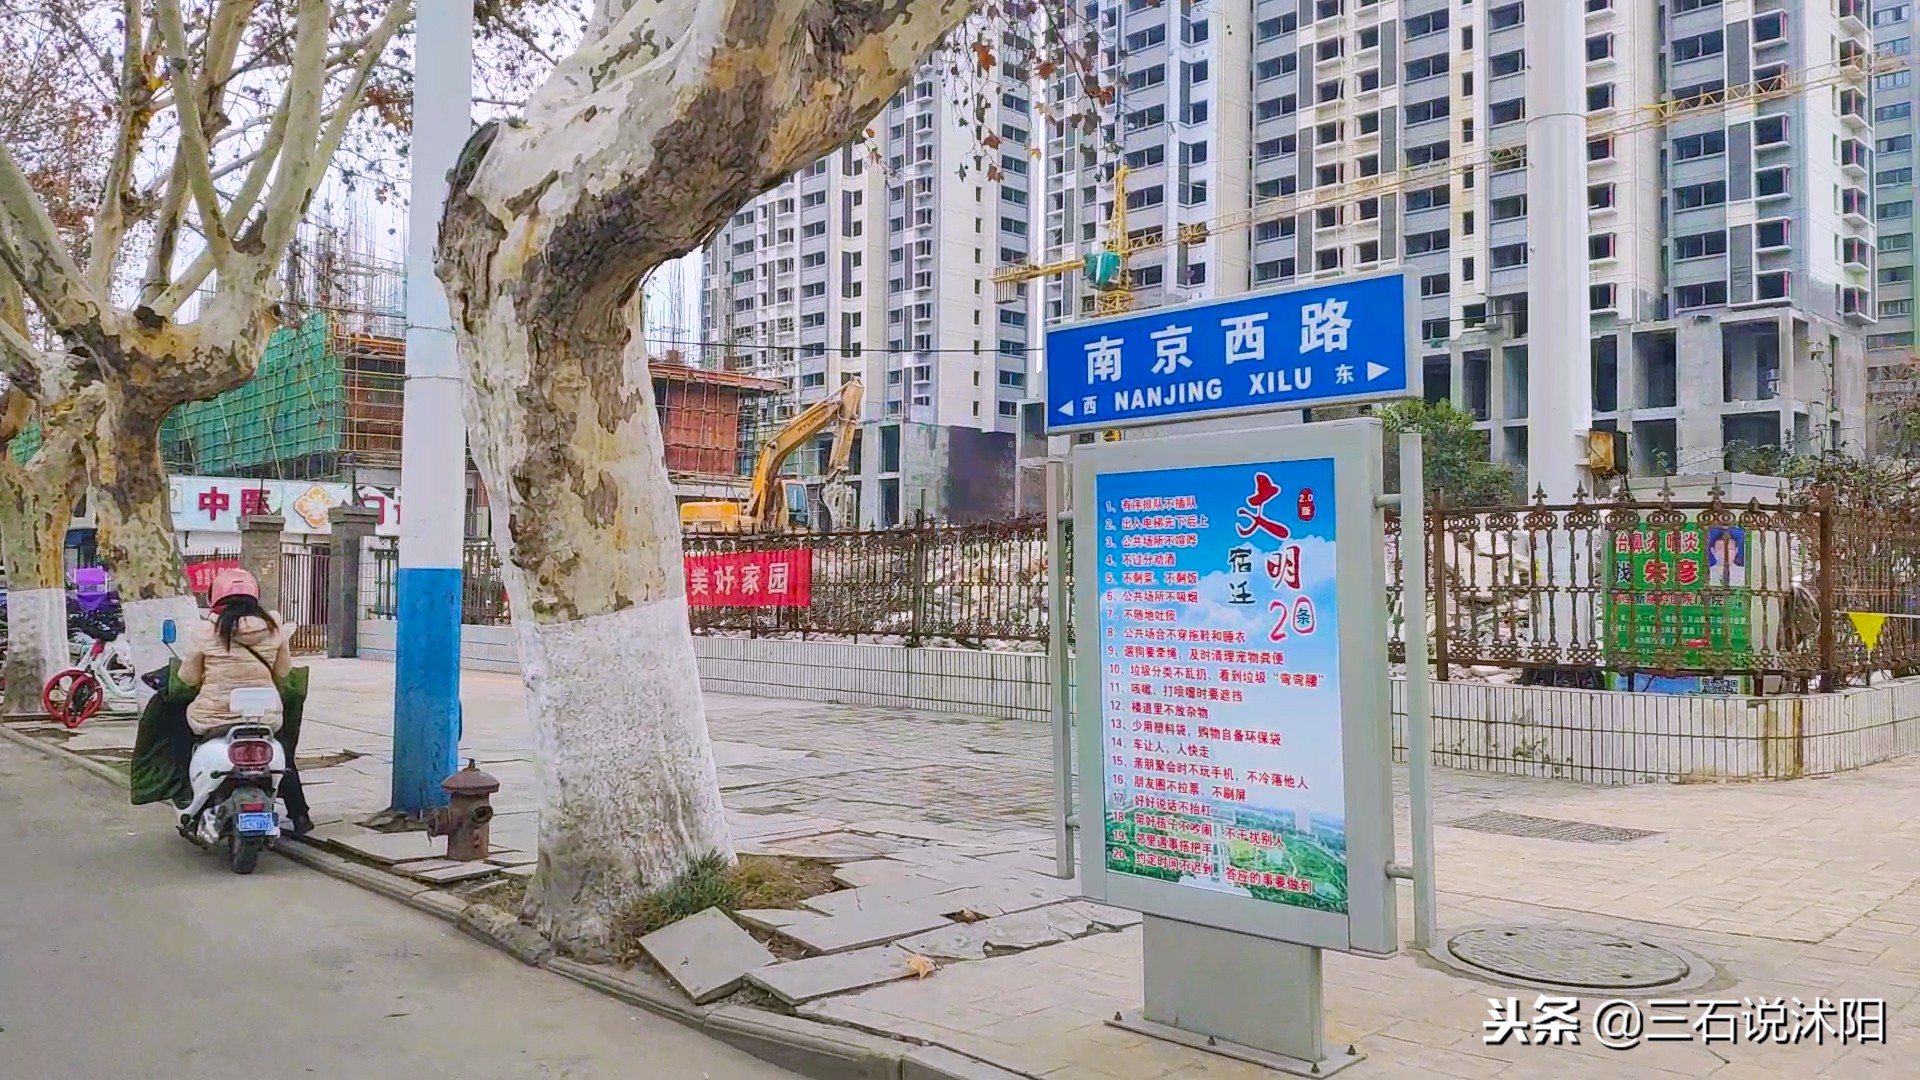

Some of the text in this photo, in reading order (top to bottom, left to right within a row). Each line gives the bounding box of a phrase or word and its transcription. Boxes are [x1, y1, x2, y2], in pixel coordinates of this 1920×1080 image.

[1083, 297, 1353, 385] 南京西路
[1082, 363, 1355, 415] 西 NANJING XILU 东
[1106, 496, 1197, 513] 1、有序排队不插队
[1299, 493, 1314, 503] 2.0
[1105, 515, 1209, 530] 2、出入电梯先下后上
[1236, 472, 1301, 589] 文明
[690, 562, 789, 596] 美好家园
[1228, 548, 1256, 604] 宿迁
[1296, 607, 1311, 625] 条
[1110, 701, 1208, 719] 12、楼道里不放杂物
